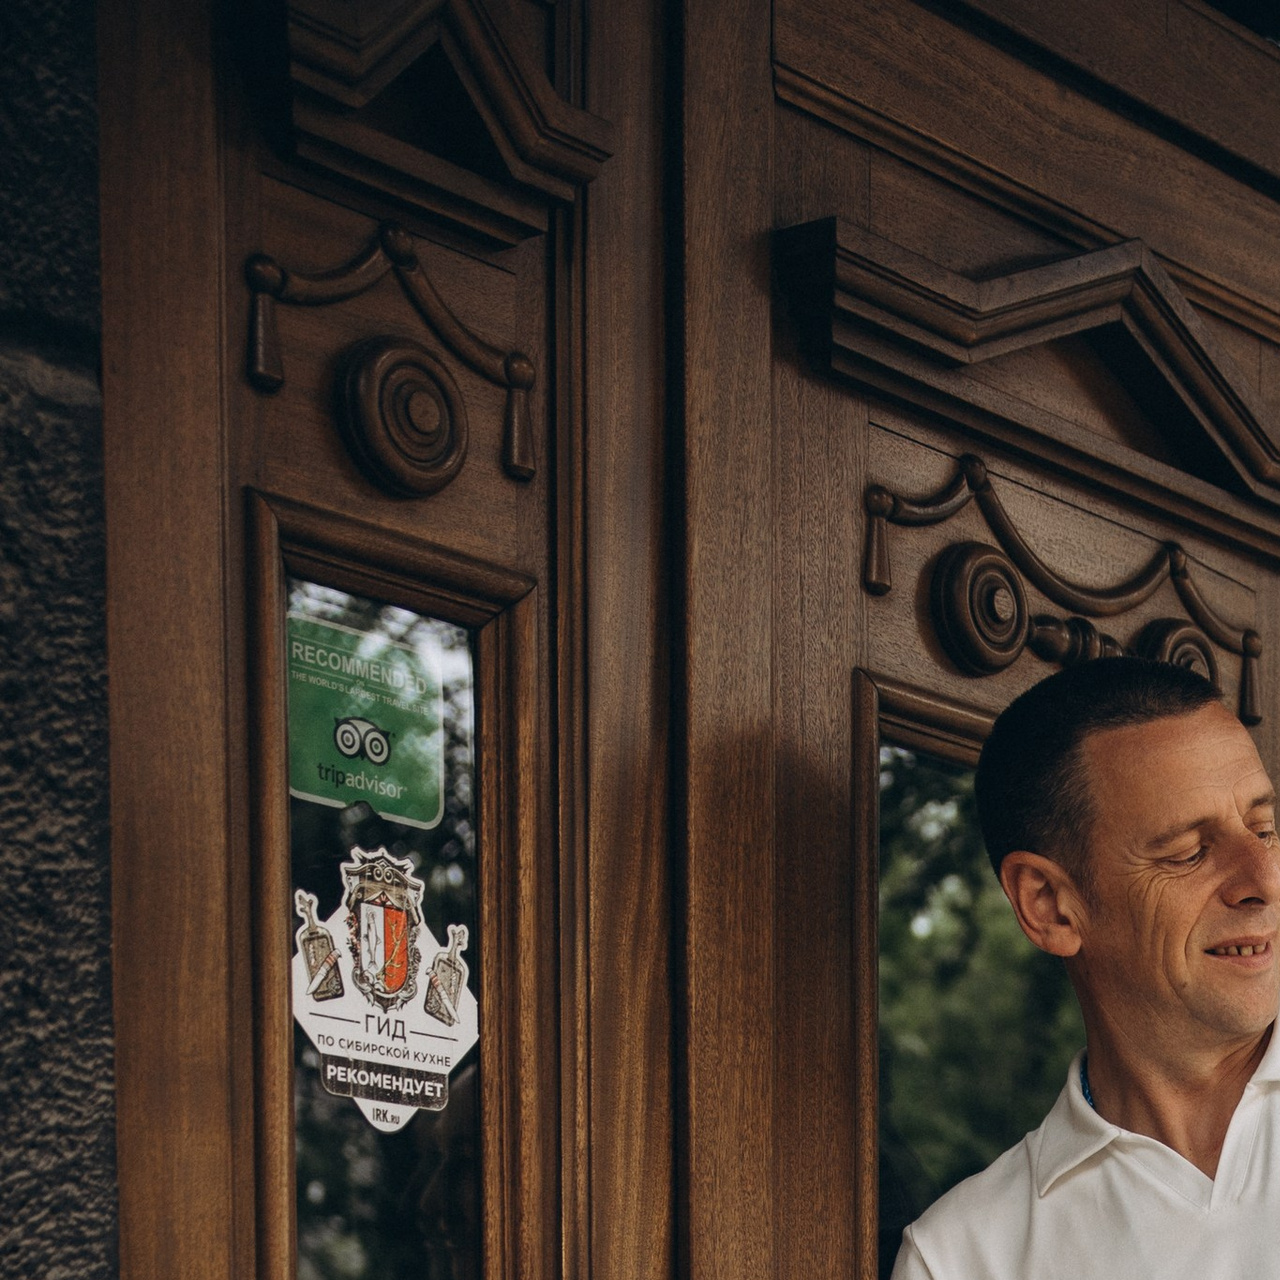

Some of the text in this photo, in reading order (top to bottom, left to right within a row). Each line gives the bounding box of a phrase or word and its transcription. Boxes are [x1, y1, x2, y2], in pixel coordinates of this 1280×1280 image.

[292, 641, 427, 695] RECOMMENDED
[291, 670, 307, 683] THE
[308, 675, 344, 693] WORLD'S
[382, 696, 411, 711] TRAVEL
[317, 763, 403, 799] tripadvisor
[365, 1014, 407, 1043] ГИД
[317, 1034, 451, 1067] ПО СИБИРСКОЙ КУХНЕ
[326, 1064, 444, 1098] РЕКОМЕНДУЕТ
[372, 1107, 400, 1125] IRK.RU
